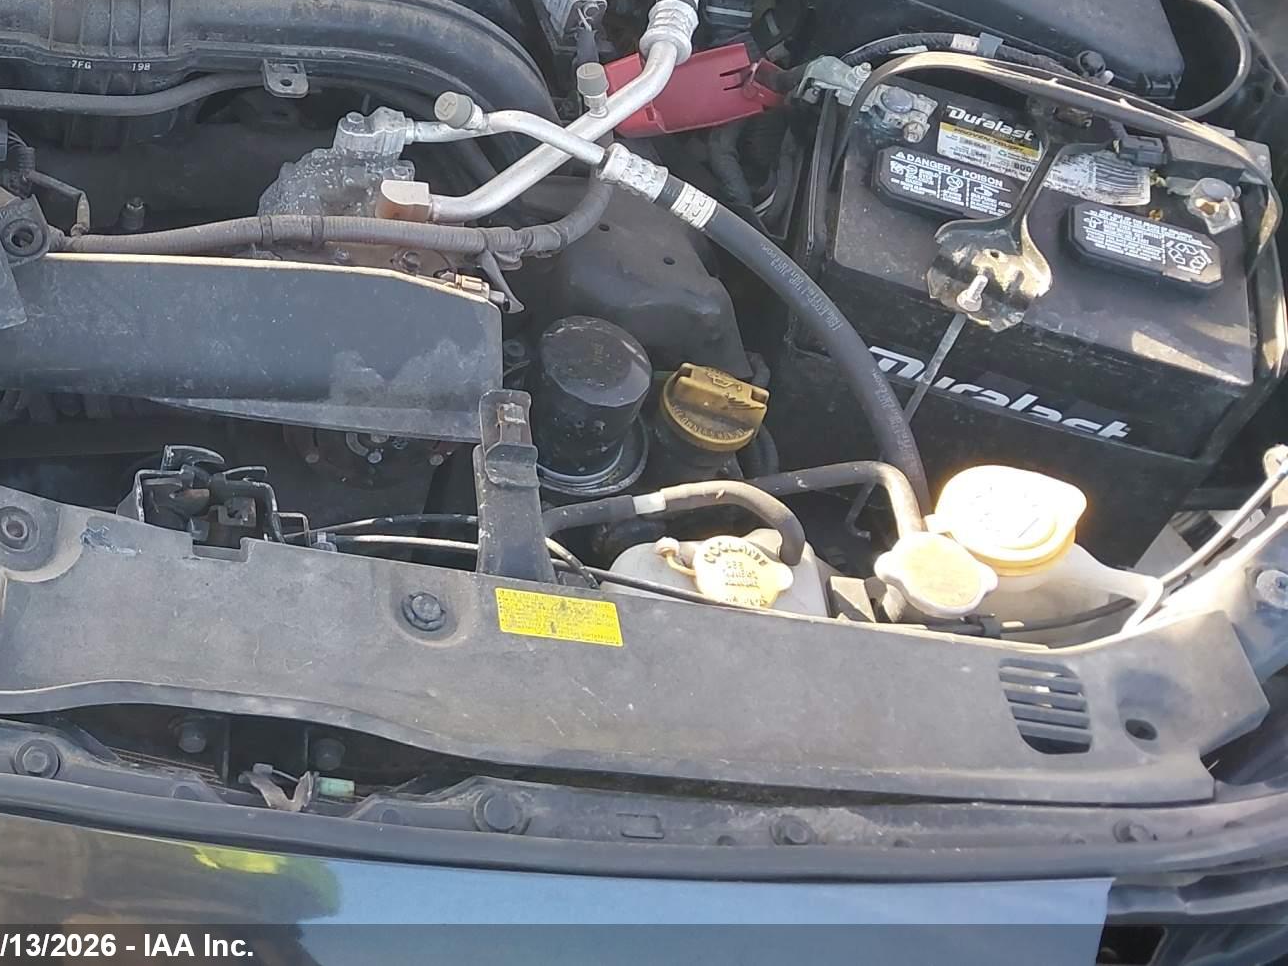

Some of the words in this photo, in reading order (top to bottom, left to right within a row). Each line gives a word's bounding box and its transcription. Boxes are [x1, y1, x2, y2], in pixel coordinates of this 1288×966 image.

[71, 60, 92, 69] 7FG
[946, 105, 1035, 141] Duralast
[907, 155, 951, 174] DANGER
[962, 169, 1004, 188] POISON
